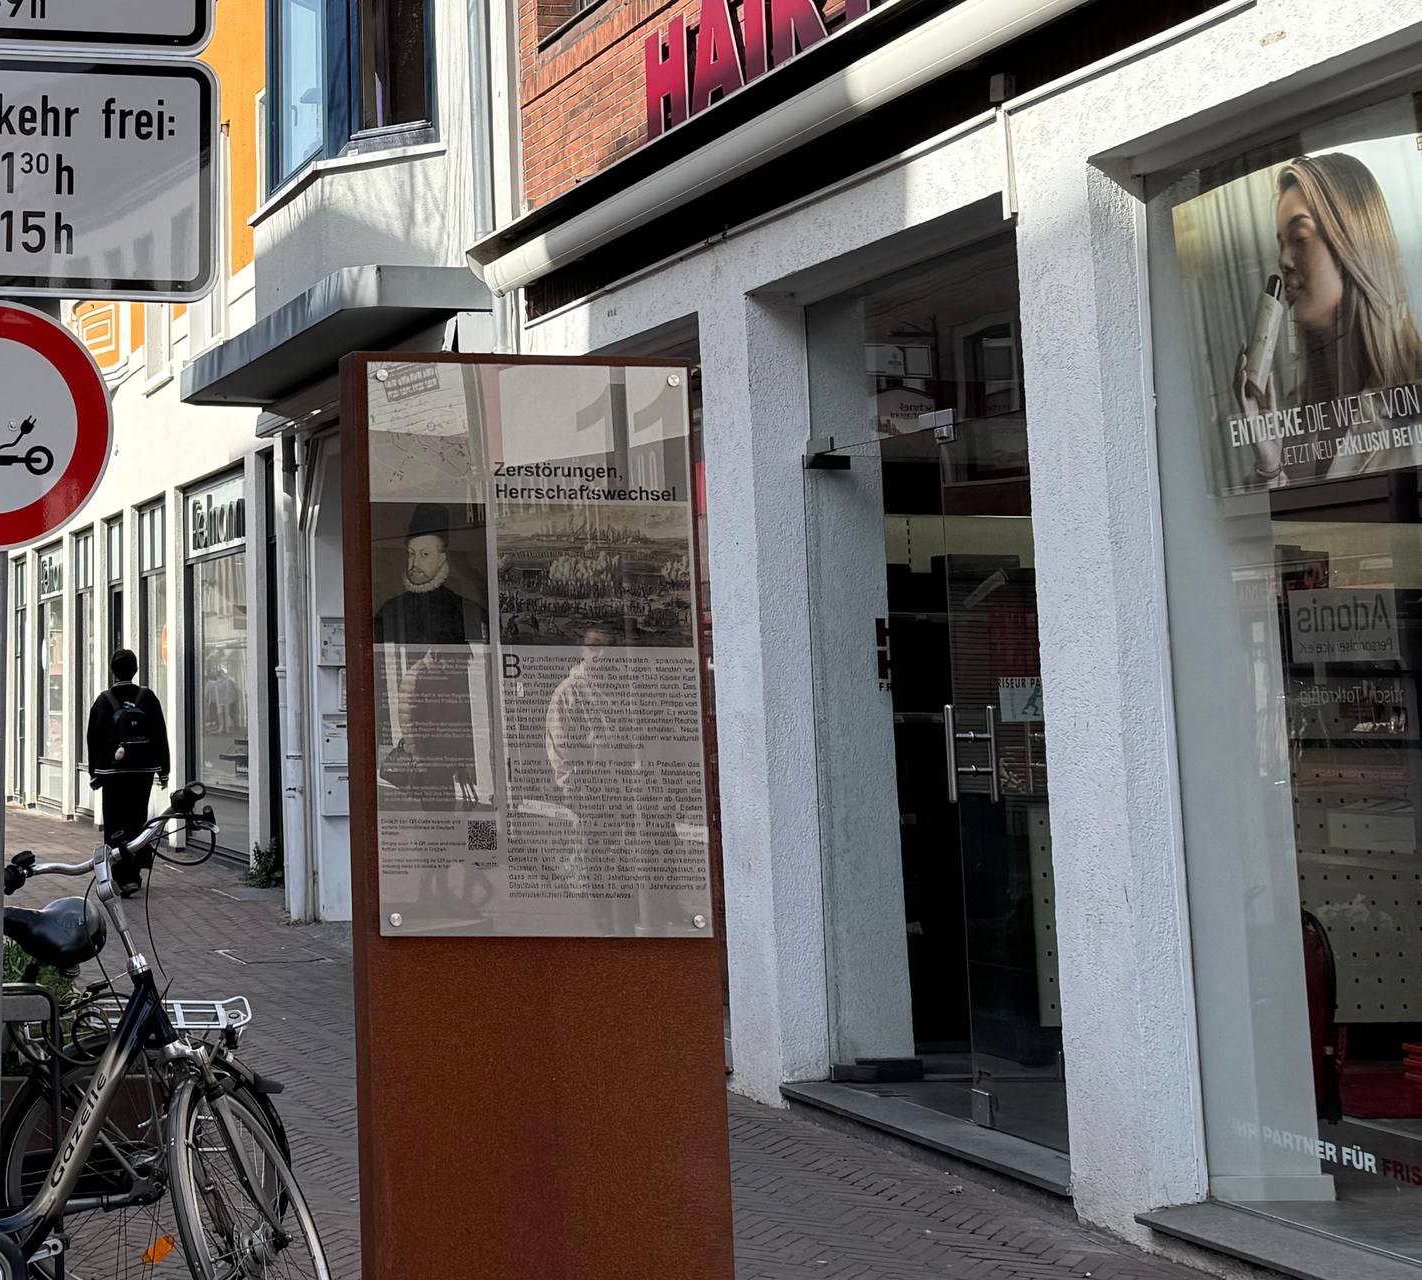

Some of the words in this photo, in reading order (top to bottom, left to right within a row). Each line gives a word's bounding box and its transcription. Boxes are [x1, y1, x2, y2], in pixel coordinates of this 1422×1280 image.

[101, 97, 176, 141] frei:
[1230, 407, 1305, 448] ENTDECKE
[1305, 401, 1331, 433] DIE
[1331, 392, 1377, 428] WELT
[1380, 385, 1421, 419] VON
[1336, 428, 1392, 457] EXKLUSIV
[494, 461, 623, 481] Zerstörungen,
[495, 483, 676, 502] Herrschaftswechsel
[994, 677, 1027, 689] RISEUR
[50, 1072, 107, 1189] Gazelle
[1261, 1125, 1338, 1164] PARTNER
[1341, 1145, 1378, 1174] FÜR
